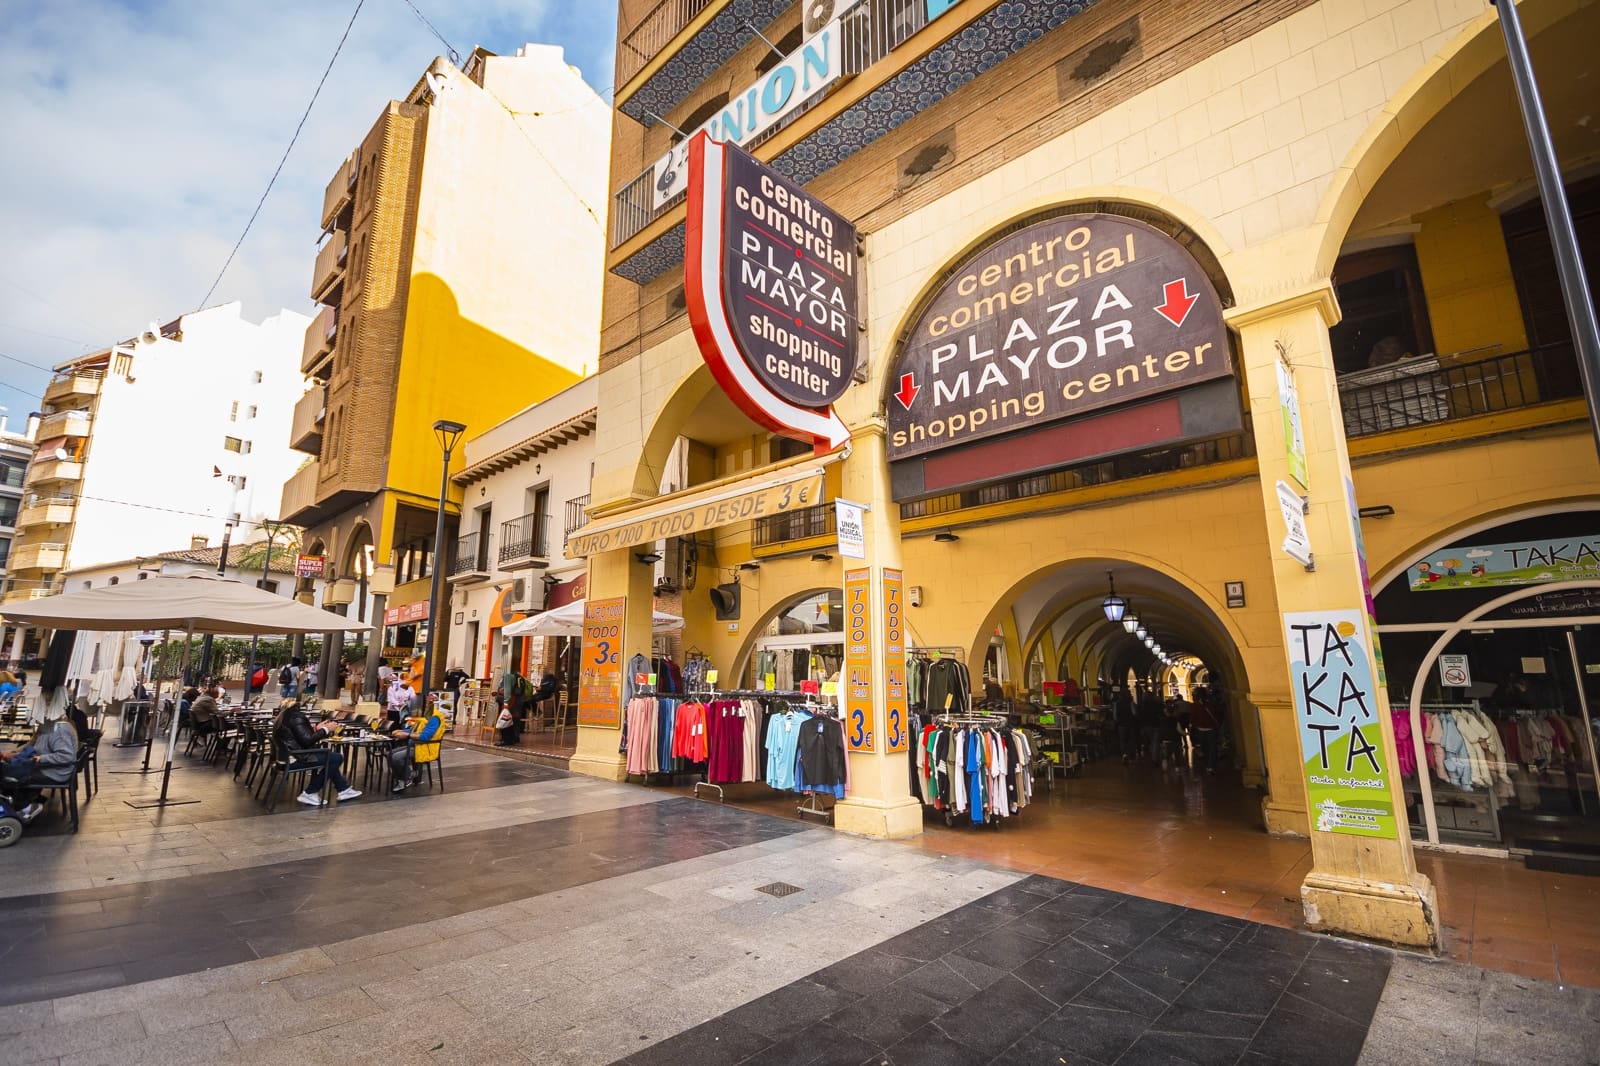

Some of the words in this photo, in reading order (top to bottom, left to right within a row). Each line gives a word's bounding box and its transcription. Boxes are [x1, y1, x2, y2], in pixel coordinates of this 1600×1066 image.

[711, 30, 829, 142] NION
[735, 186, 852, 276] comercial
[761, 174, 833, 239] centro
[742, 231, 847, 311] PLAZA
[929, 233, 1137, 337] comercial
[957, 226, 1092, 297] centro
[741, 260, 847, 337] MAYOR
[932, 284, 1133, 374] PLAZA
[750, 313, 841, 378] shopping
[765, 354, 829, 396] center
[933, 319, 1135, 406] MAYOR
[893, 389, 1045, 447] shopping
[1062, 342, 1213, 400] center
[615, 524, 643, 546] 1000
[651, 511, 695, 537] TODO
[703, 493, 768, 526] DESDE
[778, 484, 793, 510] 3
[798, 486, 809, 503] €
[840, 526, 863, 538] MUSICAL
[586, 625, 619, 639] TODO
[851, 589, 865, 642] TODO
[888, 589, 900, 642] TODO
[1290, 622, 1354, 668] TA
[851, 669, 868, 686] ALL
[1302, 671, 1370, 718] KA
[1306, 715, 1380, 774] TÁ
[1339, 778, 1384, 788] infantil
